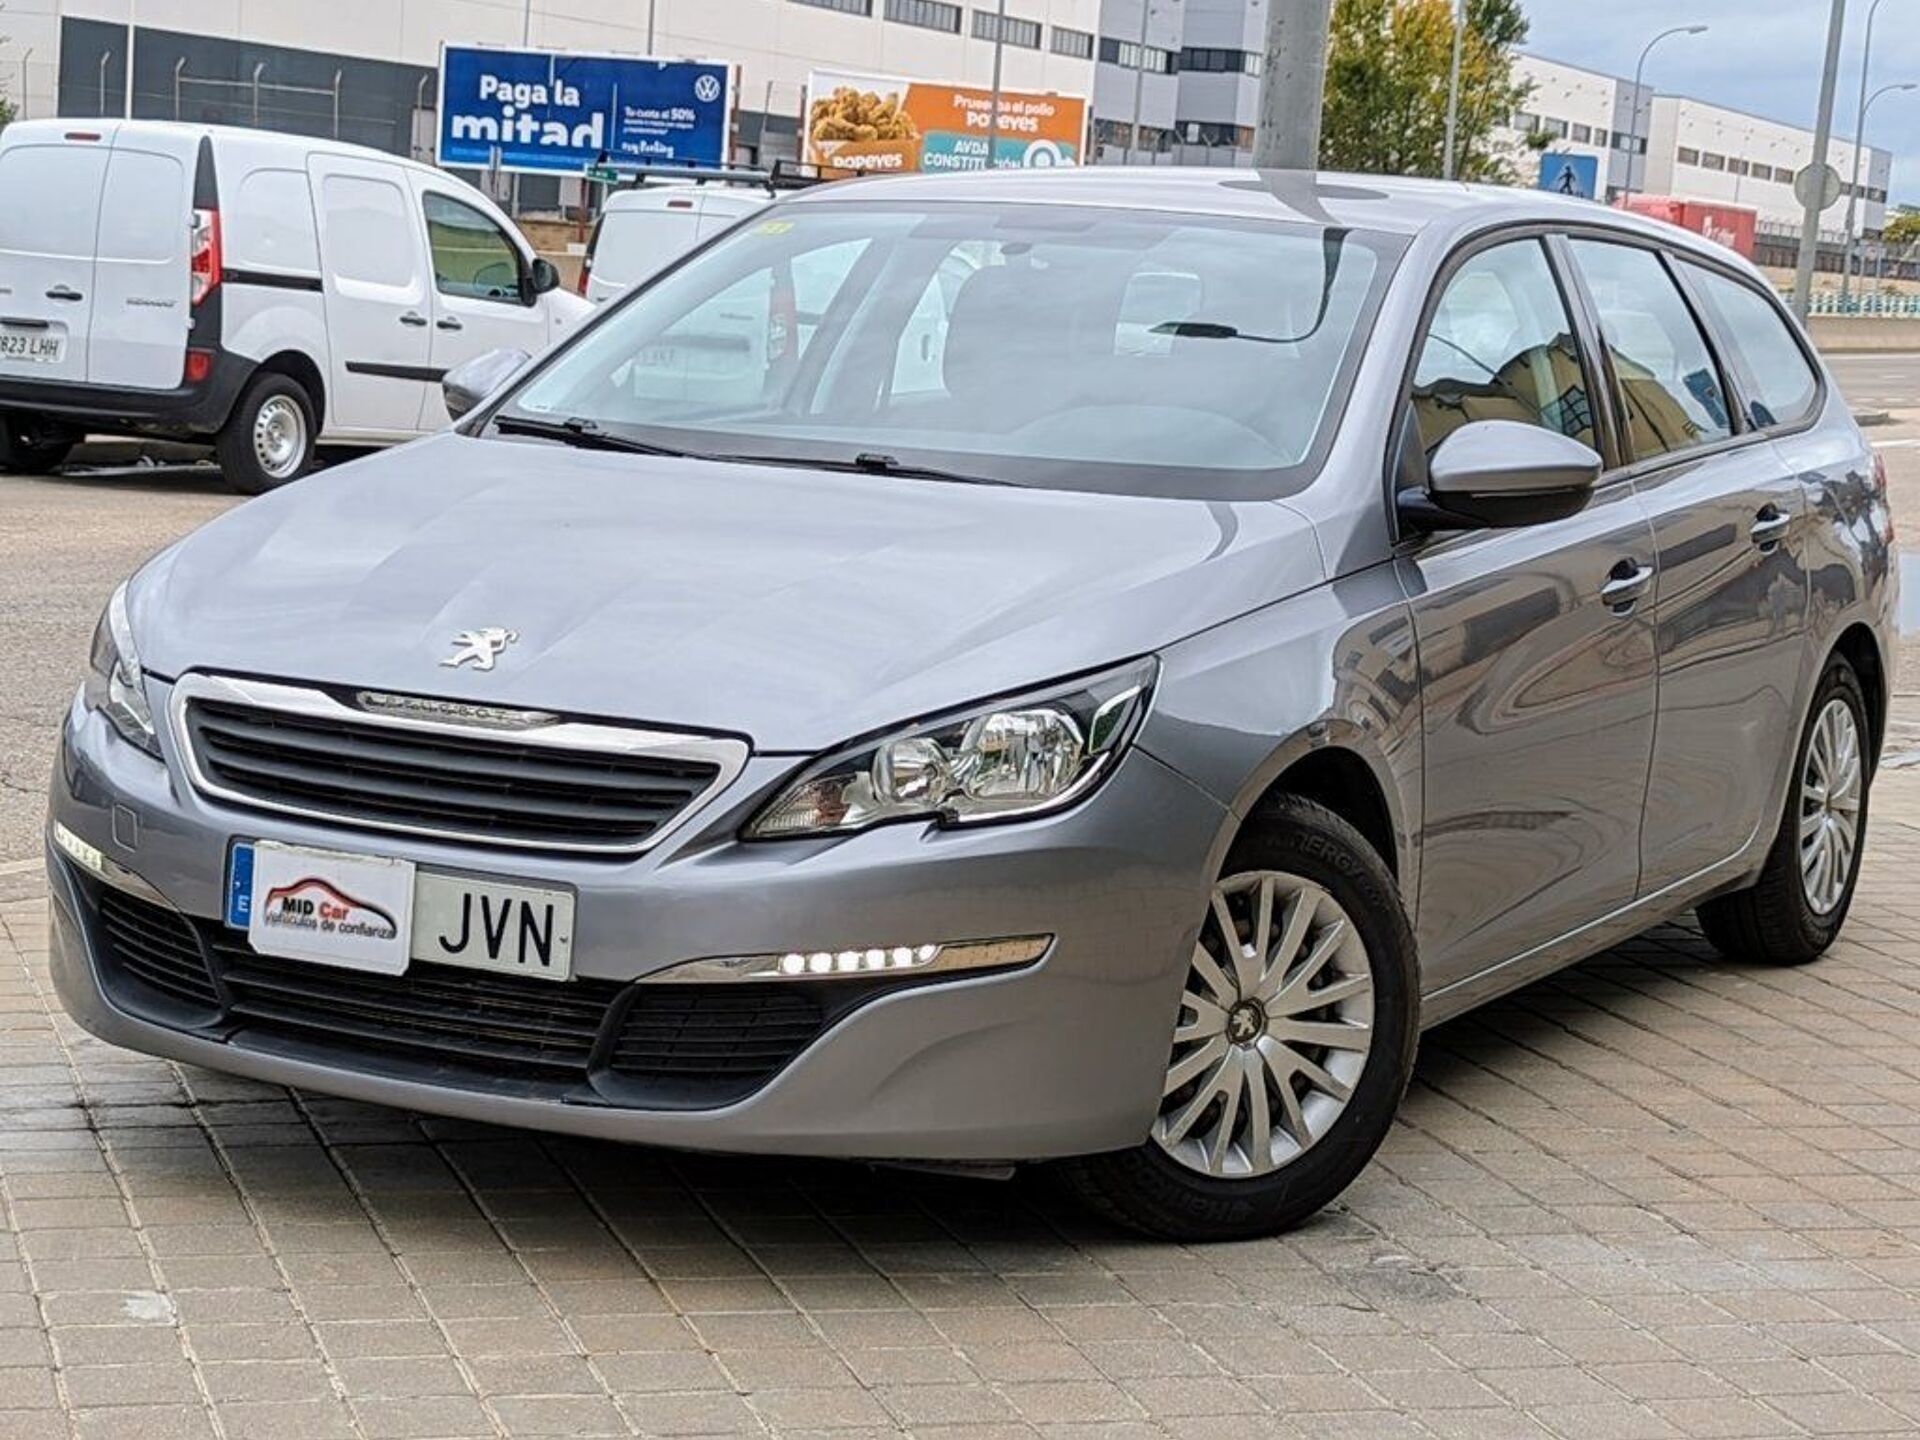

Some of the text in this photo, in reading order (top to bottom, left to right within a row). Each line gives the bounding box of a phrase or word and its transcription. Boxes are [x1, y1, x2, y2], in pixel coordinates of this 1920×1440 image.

[480, 74, 580, 109] Paga la
[1012, 100, 1025, 114] el
[1025, 102, 1056, 117] pollo
[451, 105, 605, 150] mitad
[966, 110, 1039, 133] POEYES
[954, 140, 989, 155] AVDA
[0, 335, 59, 357] 823 LHH
[238, 895, 250, 913] E
[281, 897, 349, 920] MID Car
[321, 918, 336, 933] de
[338, 921, 396, 940] confianza
[438, 892, 554, 967] JVN
